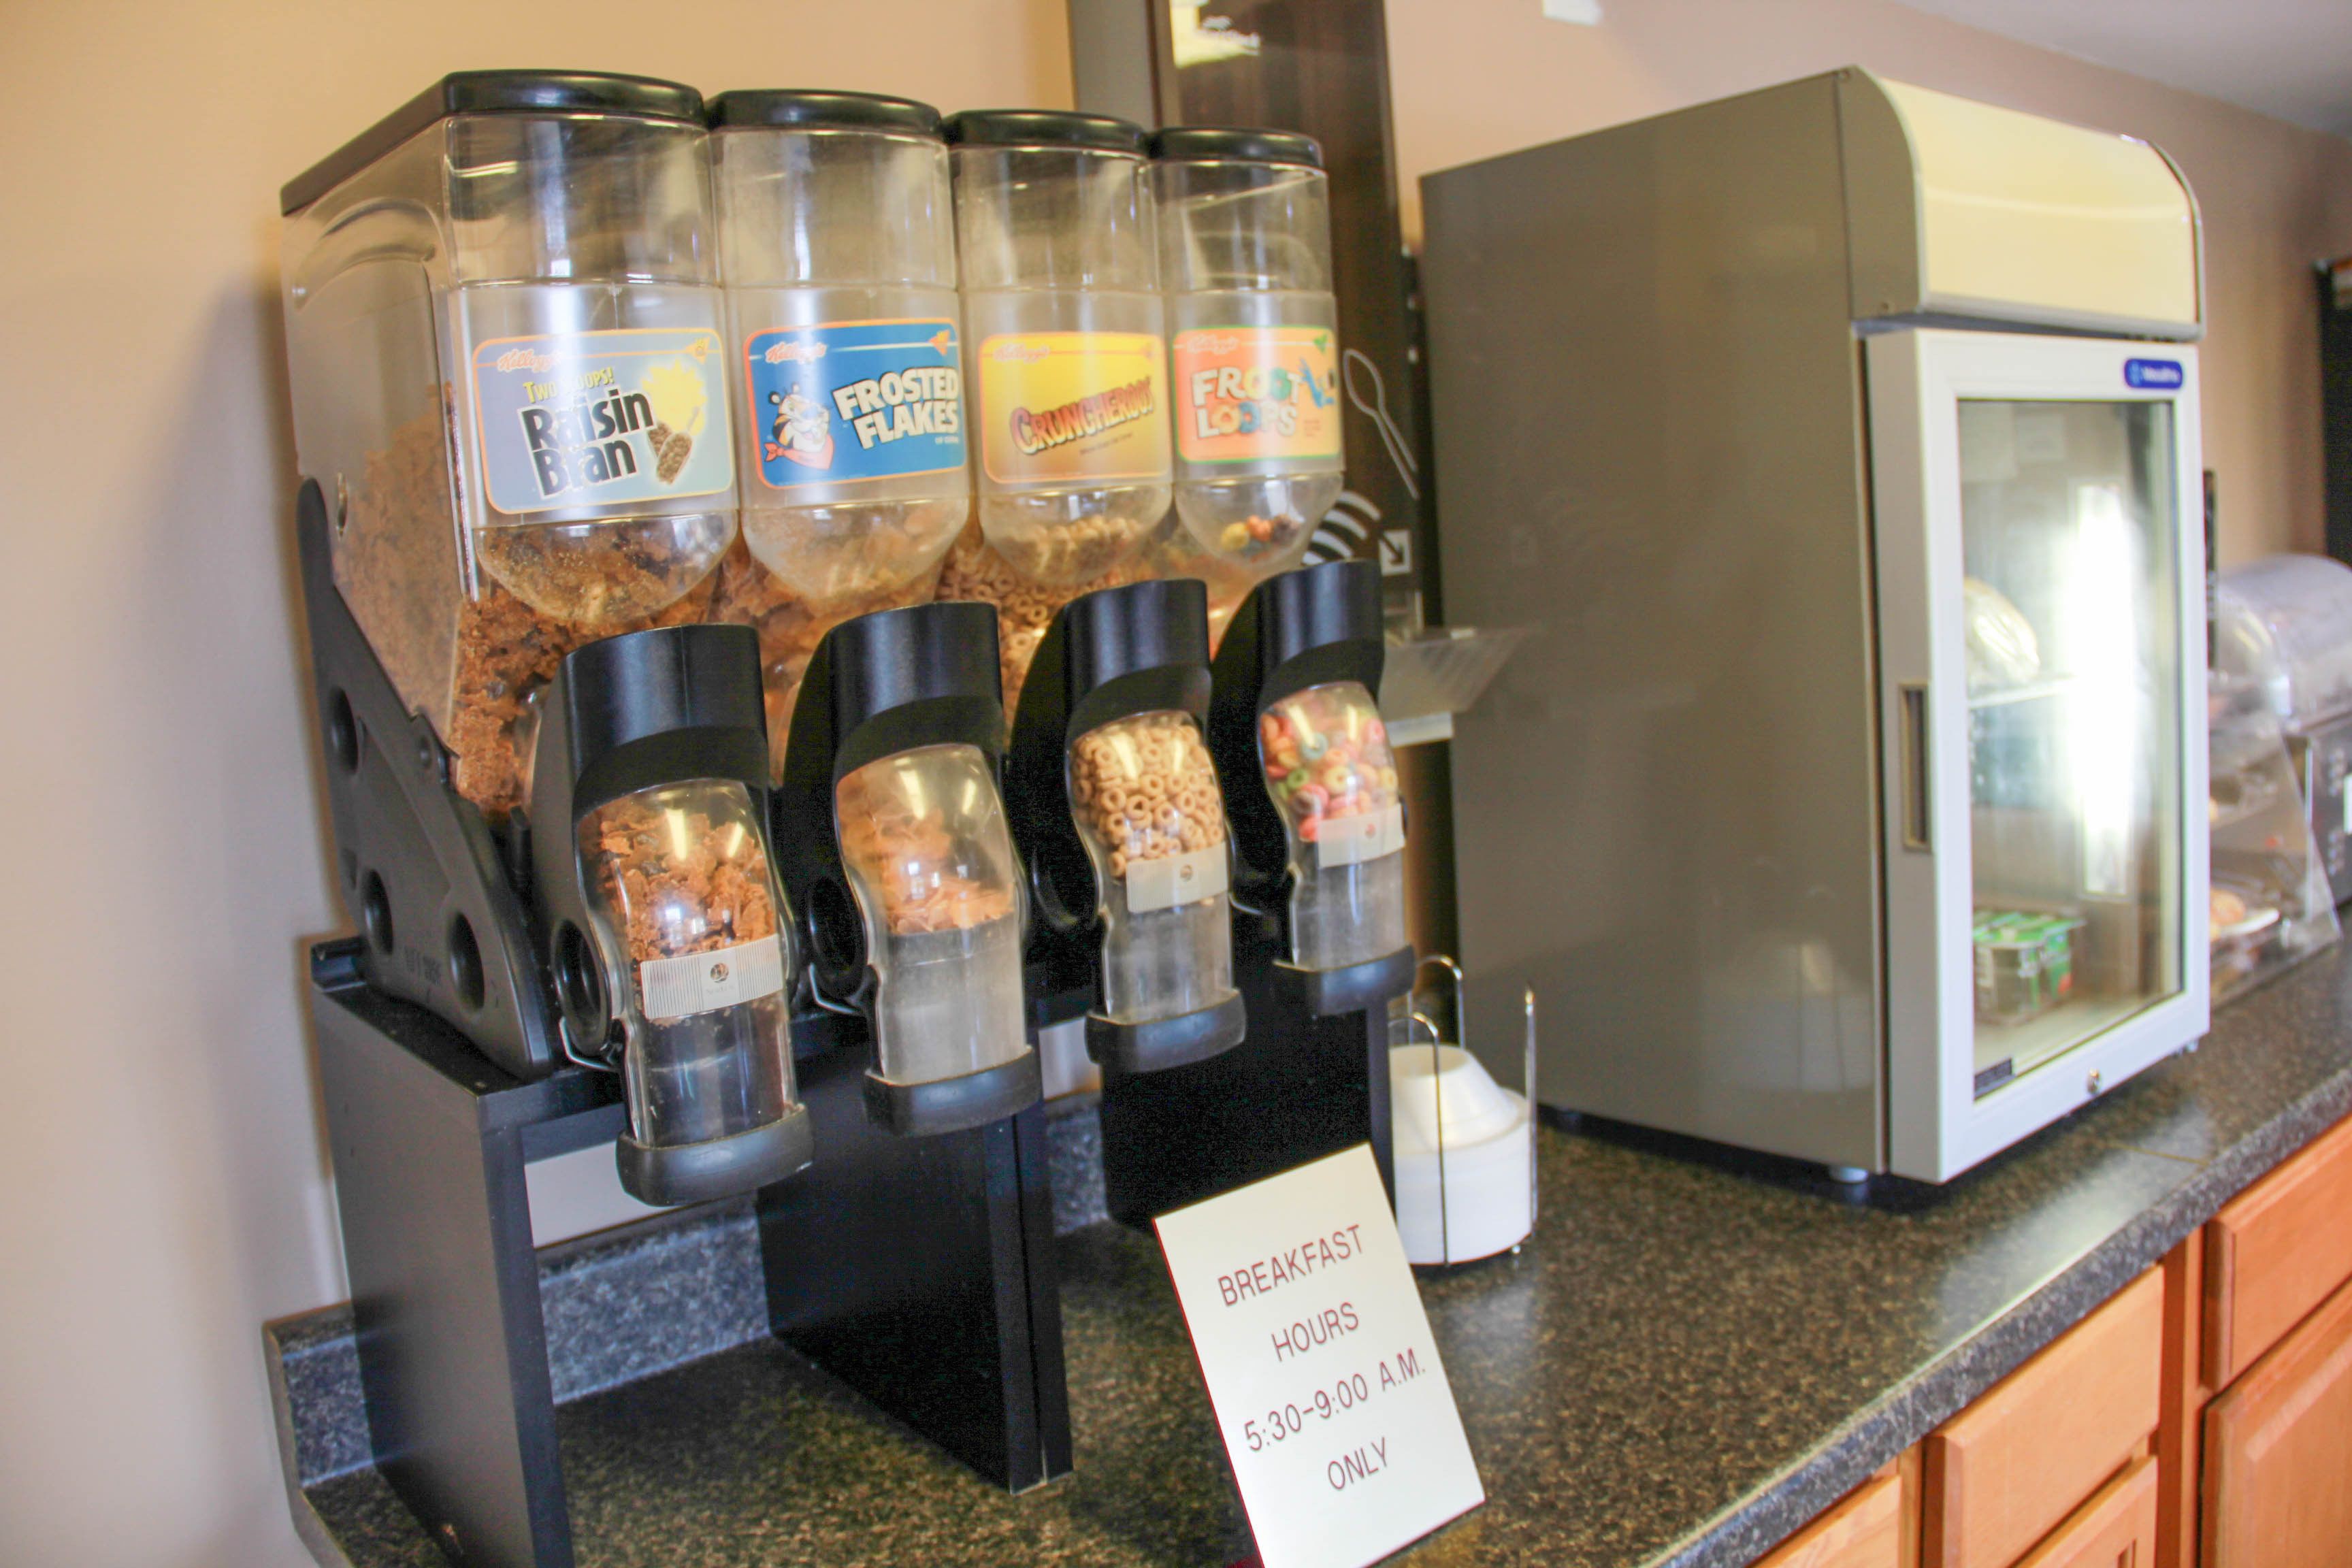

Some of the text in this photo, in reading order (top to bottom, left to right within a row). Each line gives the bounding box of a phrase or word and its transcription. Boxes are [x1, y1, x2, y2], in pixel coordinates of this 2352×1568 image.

[832, 366, 959, 421] FROSTED
[1191, 365, 1301, 406] FROOT
[519, 387, 655, 451] Raisin
[853, 399, 959, 449] FLAKES
[1195, 400, 1298, 439] LOOPS
[532, 439, 638, 497] Bran
[1218, 1224, 1363, 1307] BREAKFAST
[1271, 1302, 1360, 1362] HOURS
[1379, 1348, 1426, 1392] A.M.
[1327, 1437, 1390, 1490] ONLY
